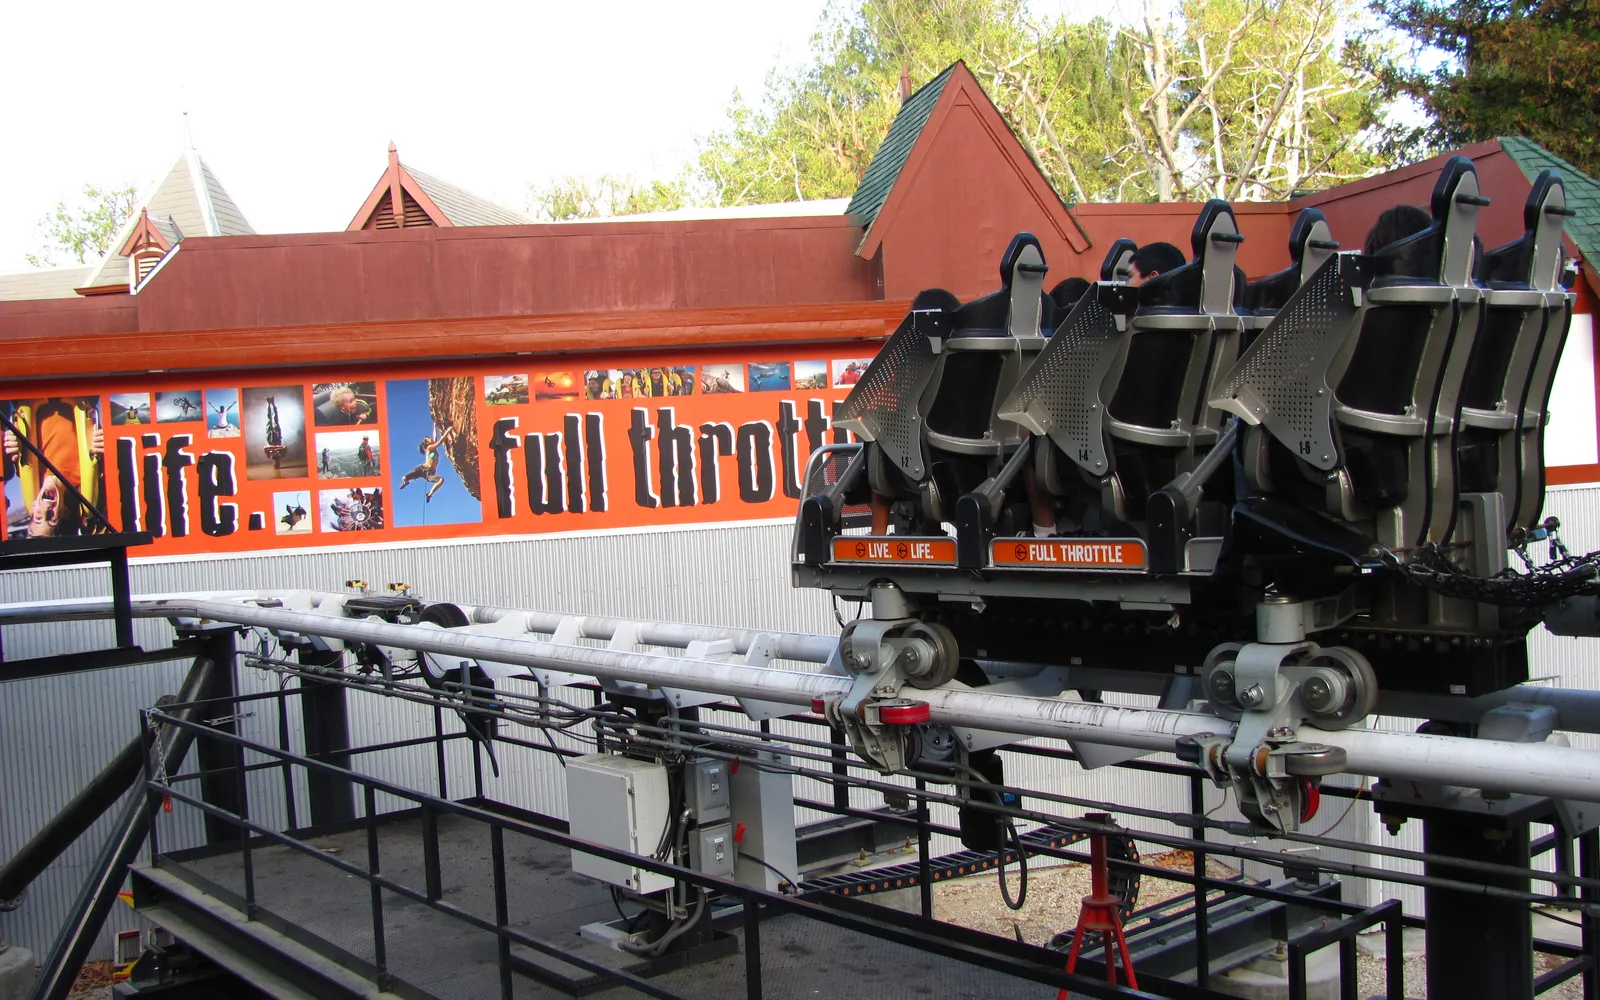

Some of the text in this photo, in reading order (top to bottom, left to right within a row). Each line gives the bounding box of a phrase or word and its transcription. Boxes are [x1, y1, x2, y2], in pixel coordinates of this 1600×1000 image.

[1078, 449, 1089, 462] 1-4
[1299, 440, 1311, 455] 1-6
[117, 432, 265, 538] life.
[489, 412, 608, 518] full
[868, 543, 934, 559] LIVE. LIFE.
[1029, 544, 1123, 563] FULL THROTTLE
